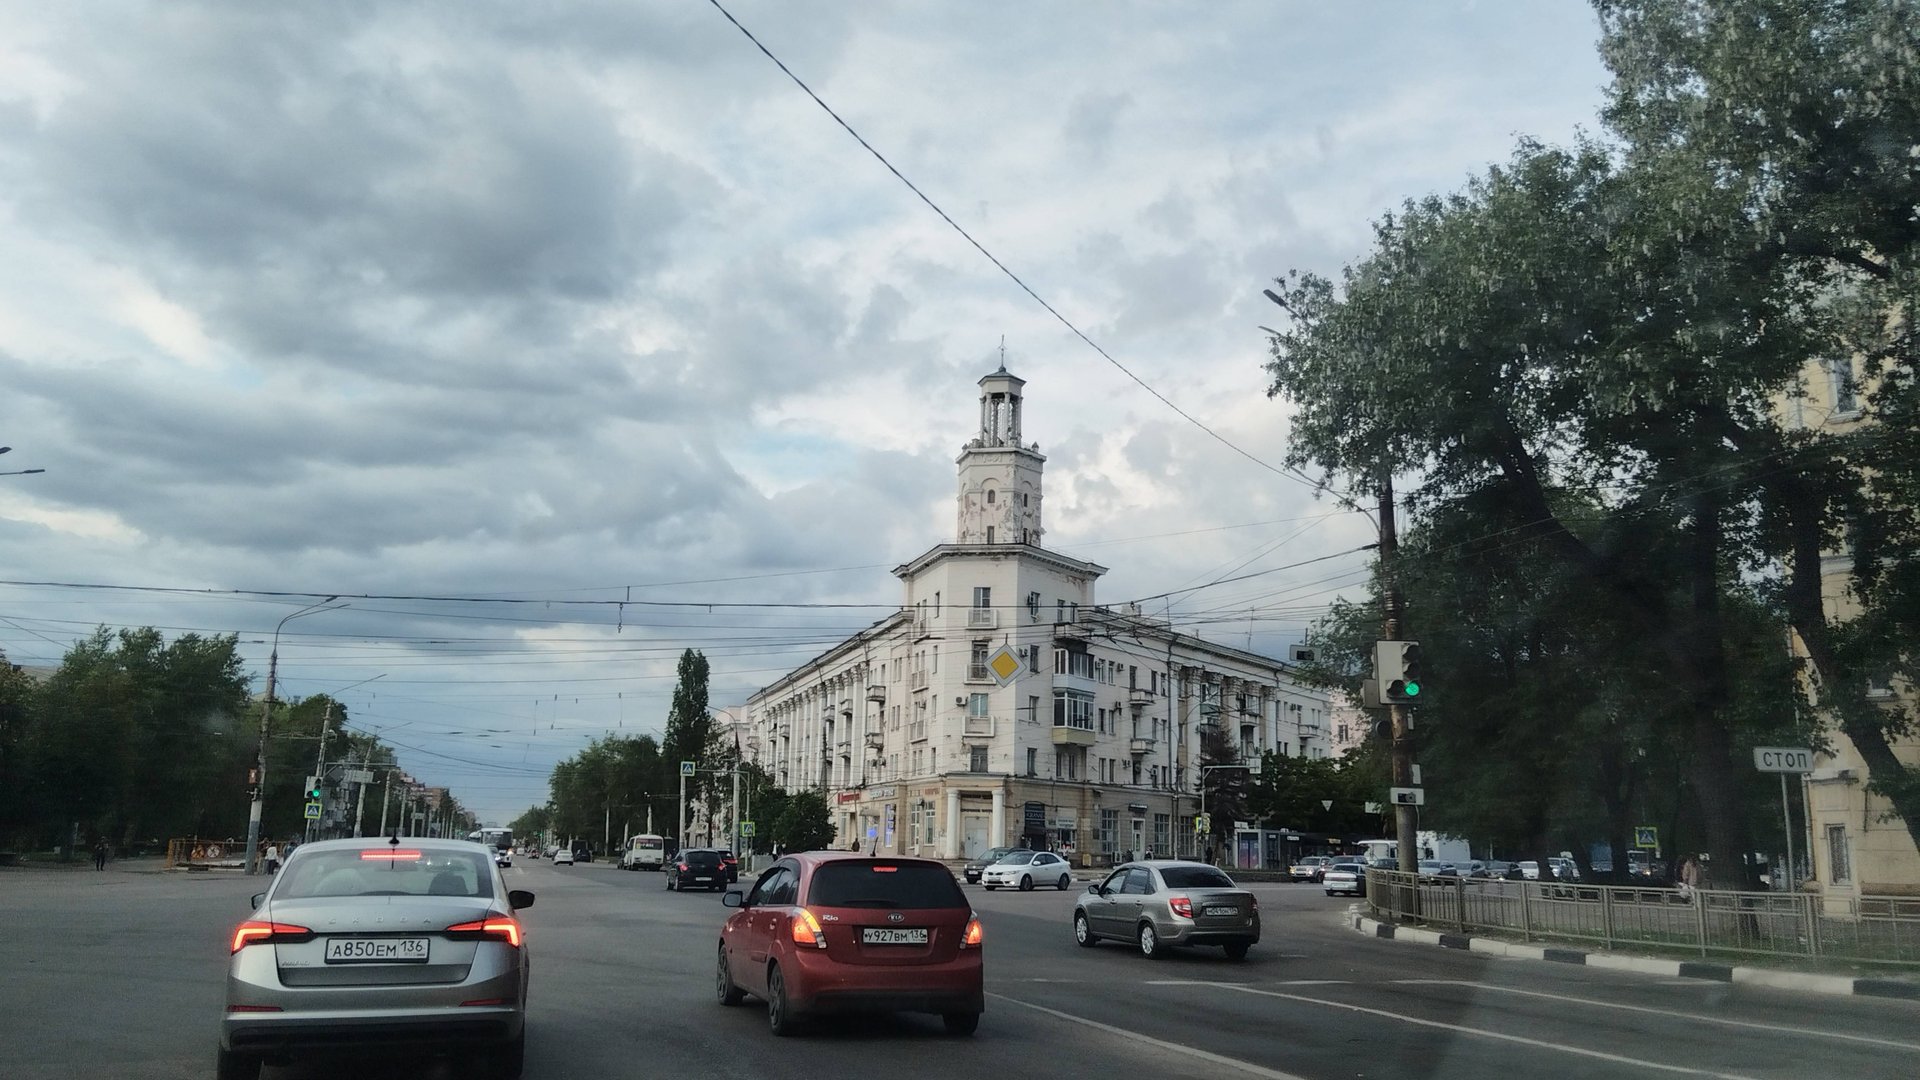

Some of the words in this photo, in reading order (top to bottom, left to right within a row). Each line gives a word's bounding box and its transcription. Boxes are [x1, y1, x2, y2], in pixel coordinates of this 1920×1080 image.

[1763, 752, 1807, 768] СТОП
[909, 929, 925, 939] 136
[333, 942, 397, 957] А850ЕМ
[401, 940, 423, 952] 136
